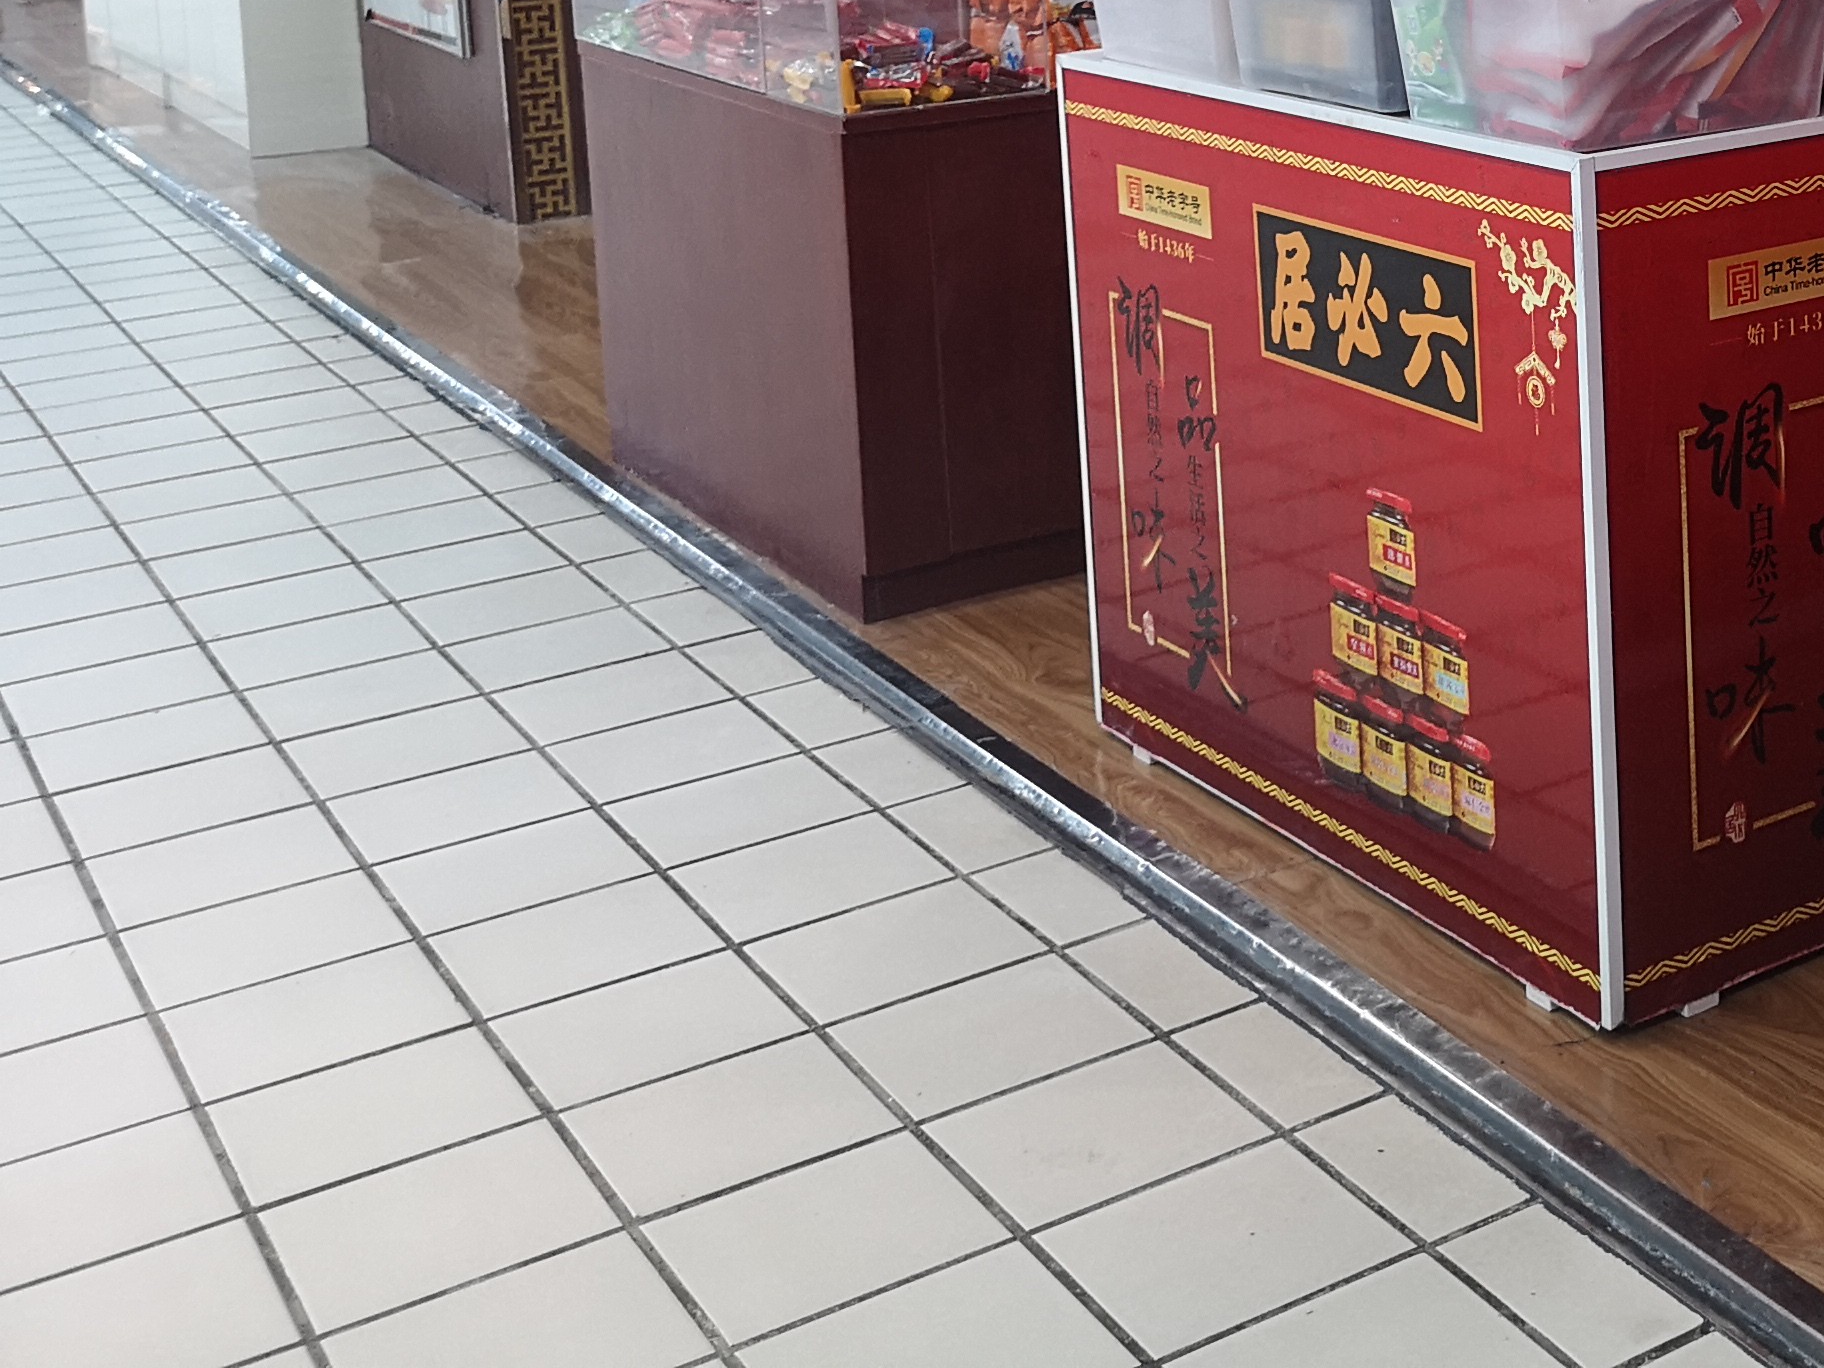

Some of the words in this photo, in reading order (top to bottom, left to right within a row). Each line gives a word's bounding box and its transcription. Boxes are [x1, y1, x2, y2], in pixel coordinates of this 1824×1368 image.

[1145, 184, 1200, 214] 中华老字号
[1138, 228, 1195, 264] 始于1436年
[1763, 283, 1788, 296] China
